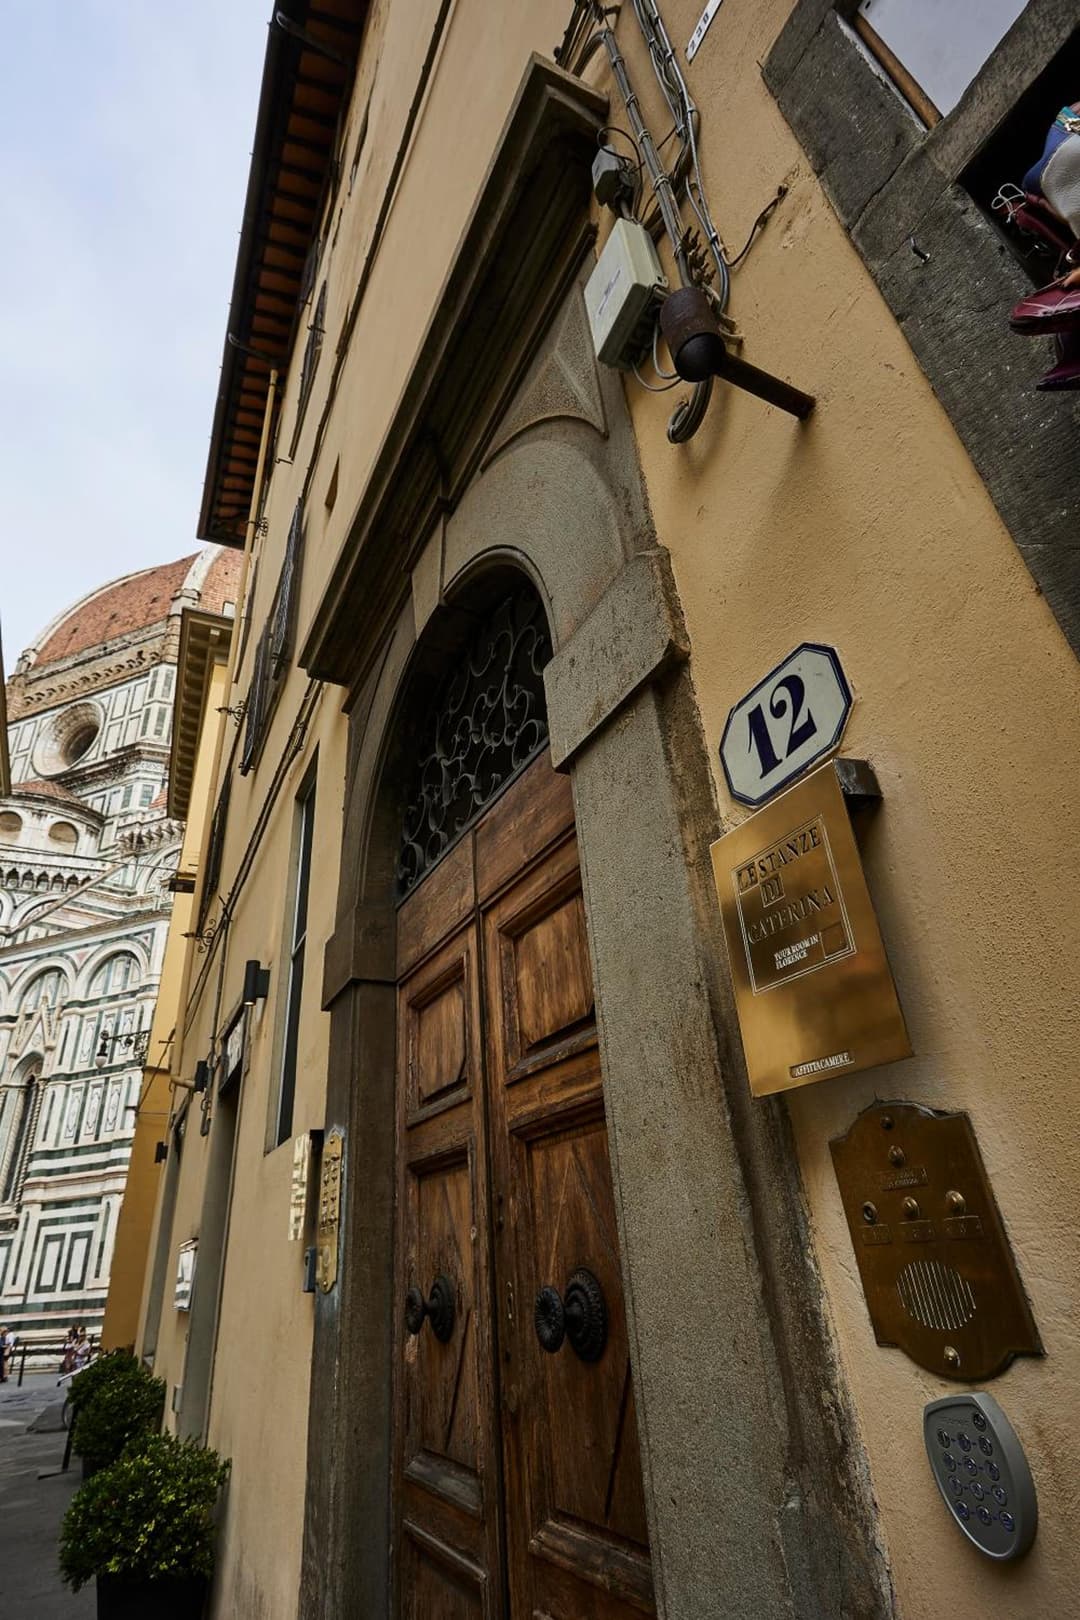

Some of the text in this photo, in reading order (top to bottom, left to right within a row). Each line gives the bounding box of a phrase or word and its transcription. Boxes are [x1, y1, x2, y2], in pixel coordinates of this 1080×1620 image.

[746, 673, 817, 780] 12
[758, 827, 822, 878] STANZE
[761, 877, 784, 902] DI
[748, 886, 834, 944] CATERINA
[775, 949, 808, 970] FLORENCE
[795, 1052, 850, 1077] AFFITTACAMERE
